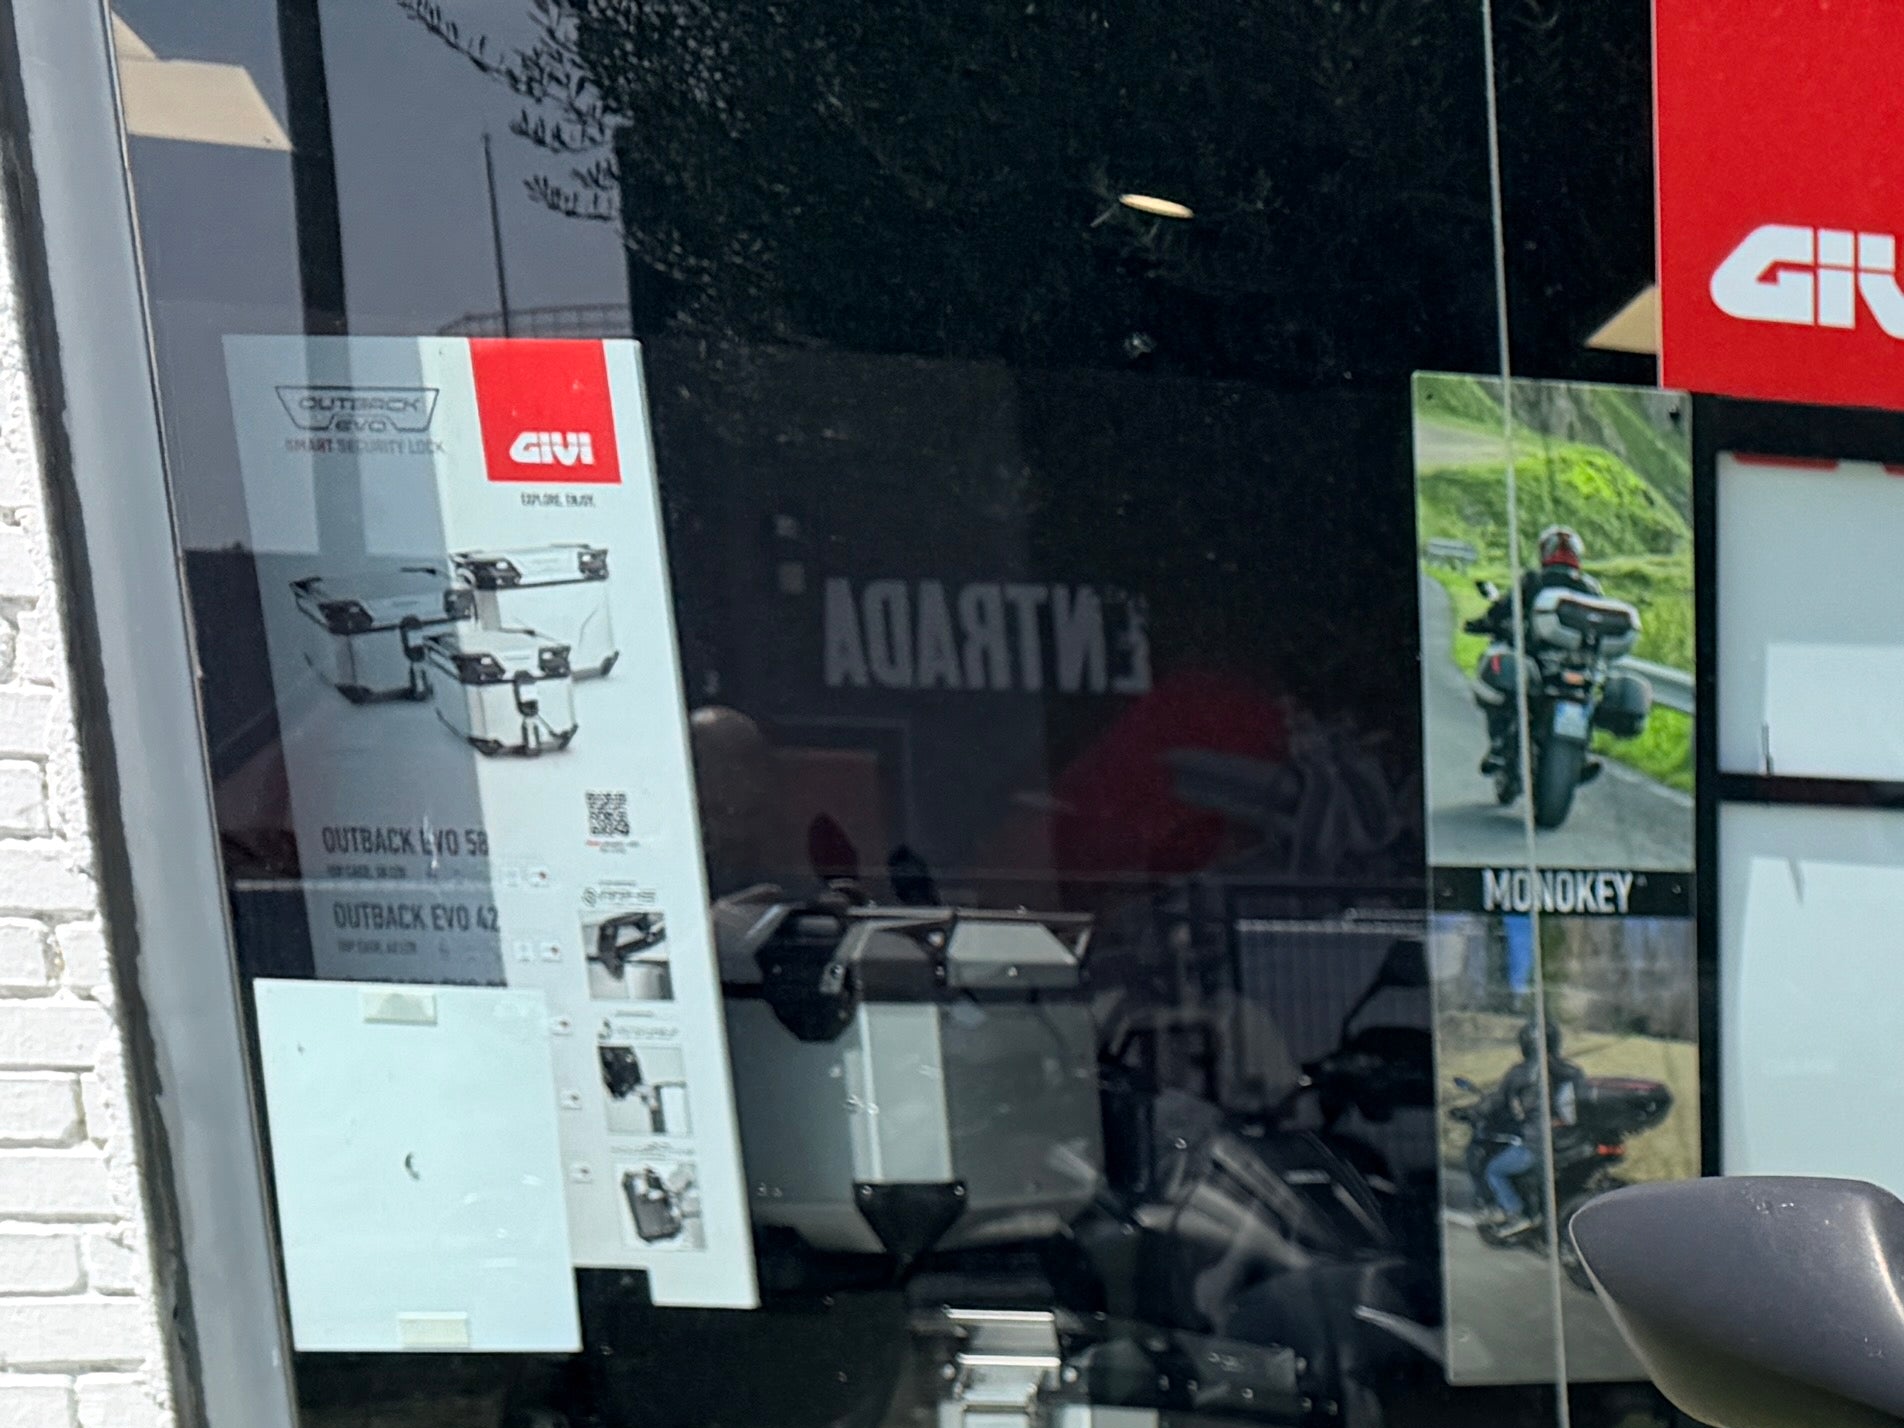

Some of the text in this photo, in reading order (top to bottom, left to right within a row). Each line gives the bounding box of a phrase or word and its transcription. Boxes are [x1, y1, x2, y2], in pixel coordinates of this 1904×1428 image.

[509, 431, 595, 466] GIVI
[322, 826, 414, 855] OUTBACK
[420, 828, 459, 856] EVO
[1481, 868, 1634, 914] MONOKEY
[333, 901, 501, 933] OUTBACK EVO 42
